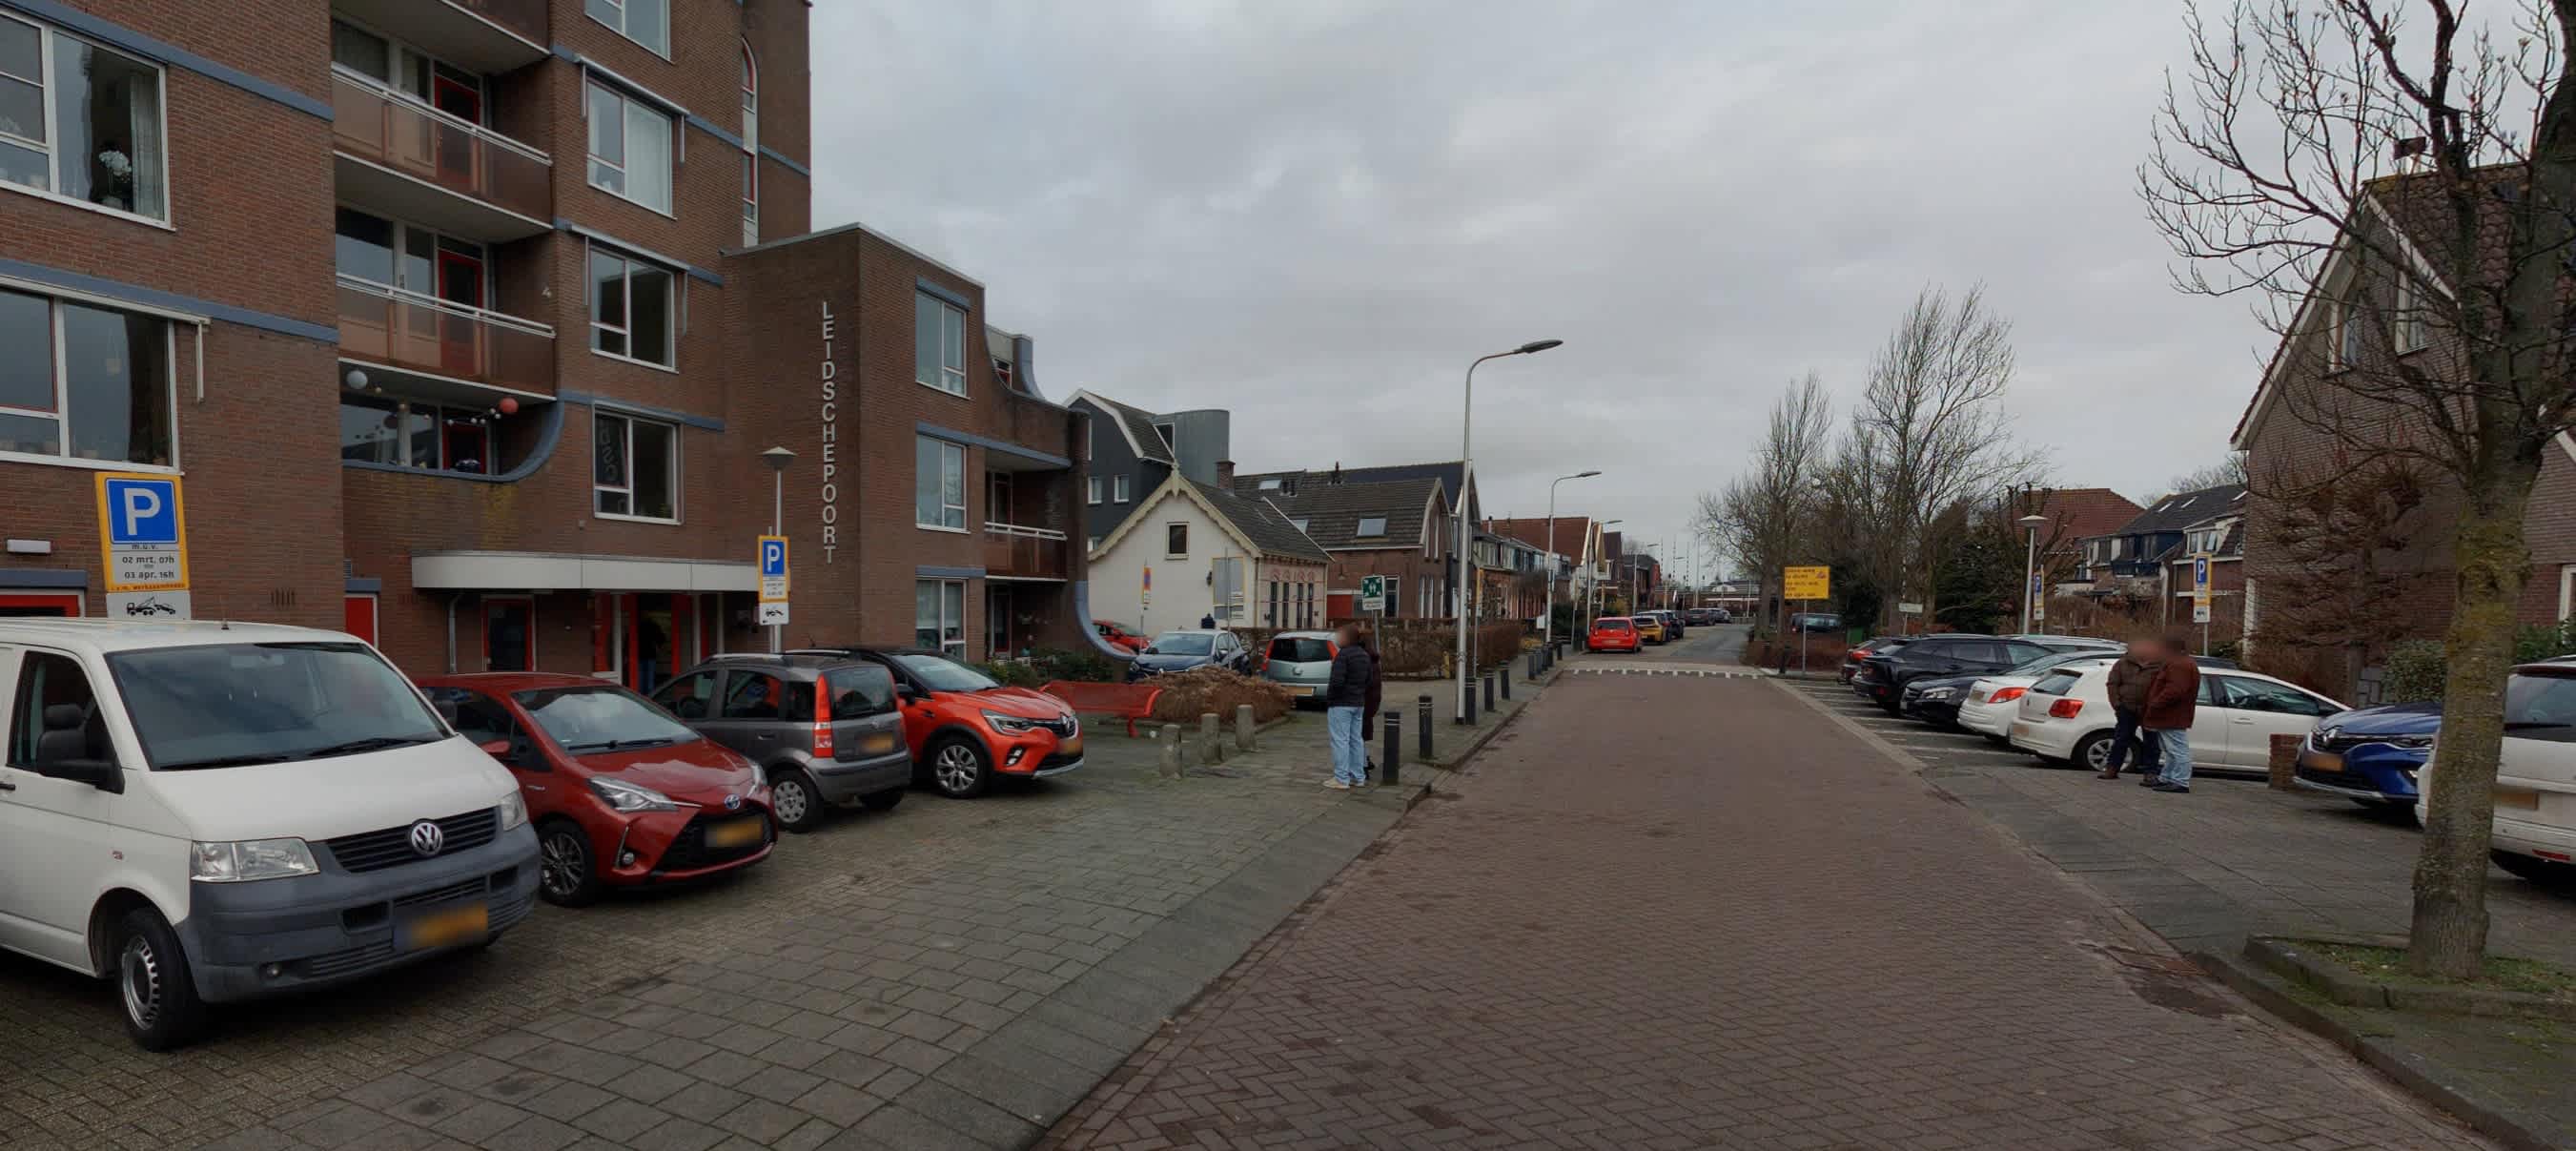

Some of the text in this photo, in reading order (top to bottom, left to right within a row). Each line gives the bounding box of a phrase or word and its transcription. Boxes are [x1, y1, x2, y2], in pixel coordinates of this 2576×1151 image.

[822, 301, 837, 564] LEIDSCHEPOORT
[124, 487, 161, 536] P
[122, 556, 133, 565] 02
[767, 545, 781, 572] P
